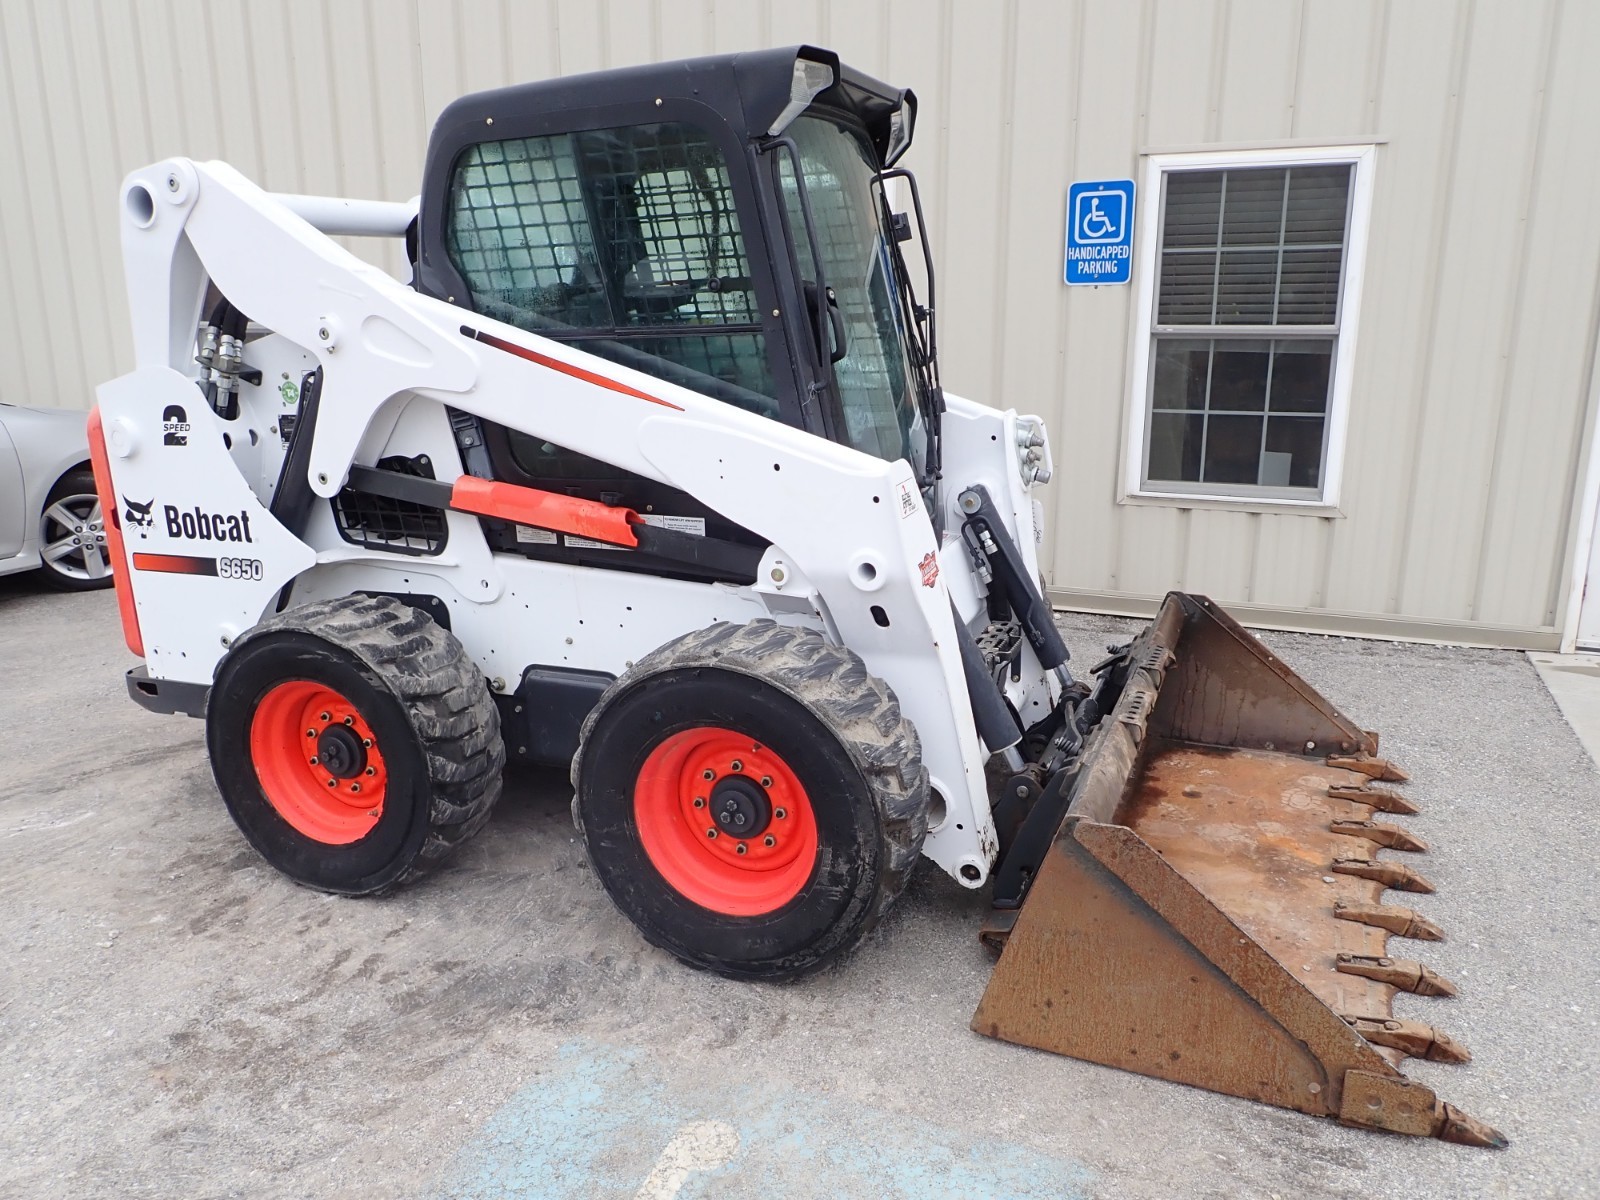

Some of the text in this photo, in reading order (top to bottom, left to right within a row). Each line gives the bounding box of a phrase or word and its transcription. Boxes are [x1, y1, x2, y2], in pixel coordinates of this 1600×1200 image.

[1068, 245, 1129, 260] HANDICAPPED
[1078, 260, 1118, 274] PARKING
[163, 404, 187, 446] 2
[163, 423, 191, 432] SPEED
[163, 505, 253, 543] Bobcat
[220, 557, 263, 581] S650
